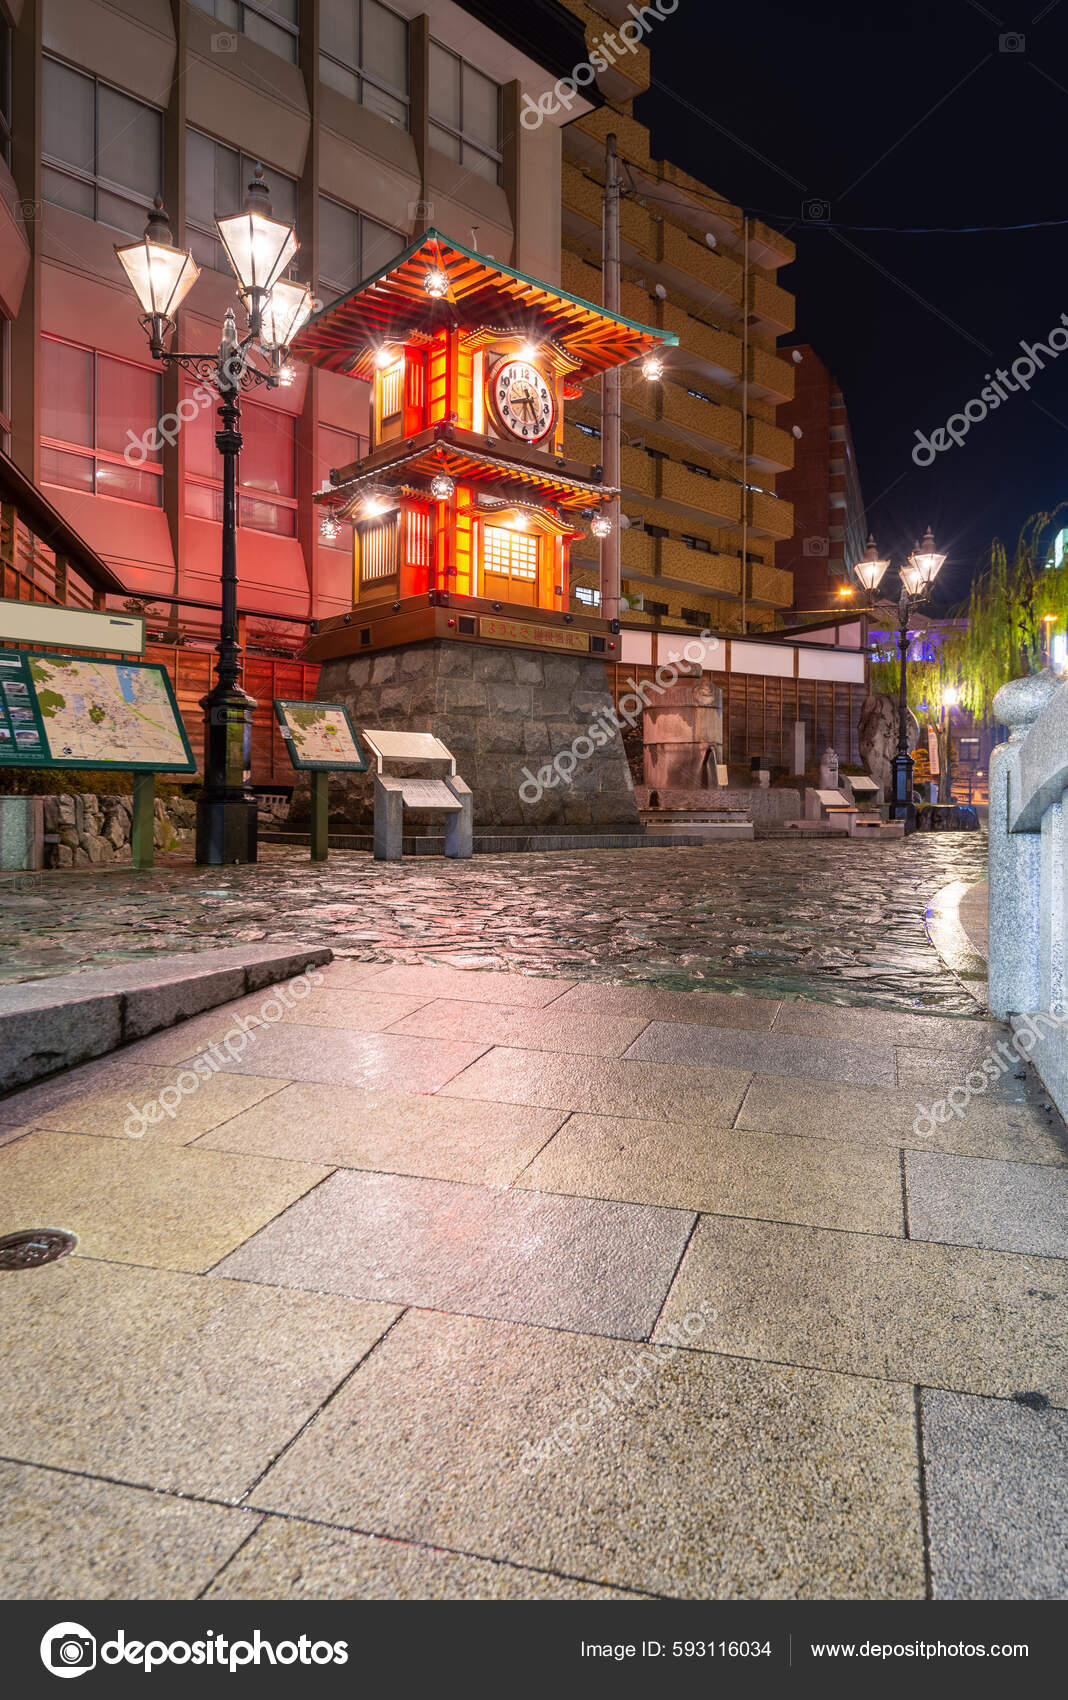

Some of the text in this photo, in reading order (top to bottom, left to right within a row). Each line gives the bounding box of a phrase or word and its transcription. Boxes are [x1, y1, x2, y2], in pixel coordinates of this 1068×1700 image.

[499, 391, 505, 401] 9
[541, 388, 547, 399] 2
[503, 405, 509, 416] 8
[543, 403, 549, 414] 3
[511, 418, 517, 429] 7
[522, 426, 528, 436] 6
